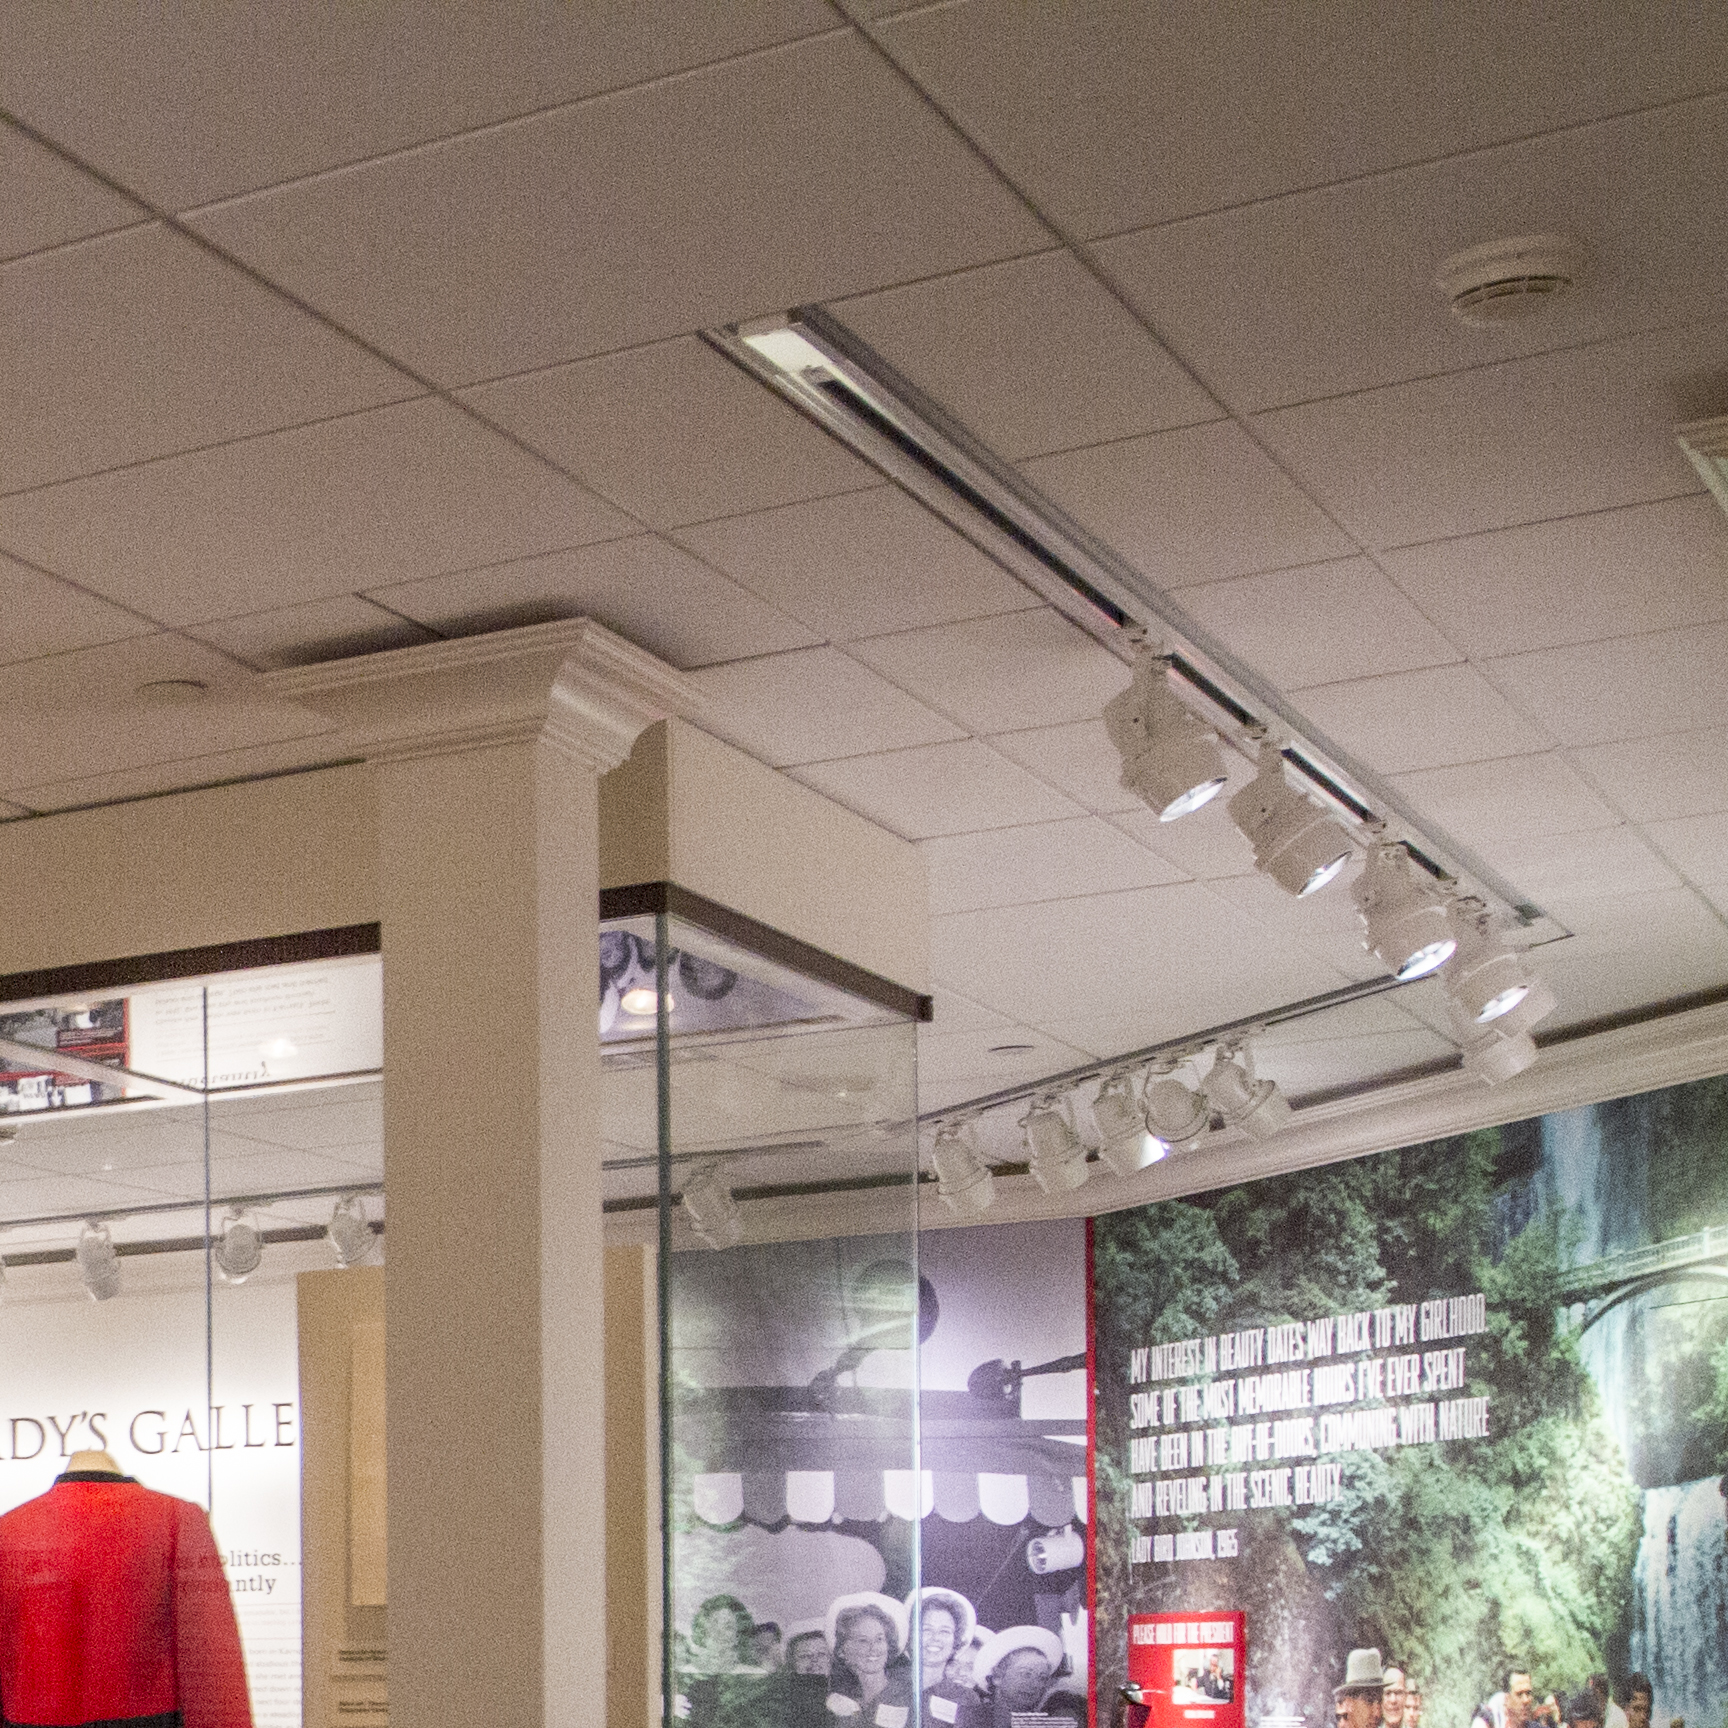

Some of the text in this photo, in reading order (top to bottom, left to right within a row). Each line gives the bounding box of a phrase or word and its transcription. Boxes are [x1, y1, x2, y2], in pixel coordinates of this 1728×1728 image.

[1130, 1347, 1149, 1383] MY
[1151, 1339, 1203, 1380] INTEREST
[1204, 1336, 1217, 1374] IN
[1219, 1329, 1265, 1370] BEAUTY
[1267, 1323, 1305, 1365] DATES
[1306, 1317, 1335, 1359] WAY
[1336, 1313, 1373, 1354] BACK
[1374, 1309, 1393, 1348] TO
[1393, 1304, 1417, 1346] MY
[1130, 1393, 1160, 1429] SOME
[1162, 1390, 1178, 1424] OF
[1179, 1386, 1201, 1423] THE
[1203, 1380, 1235, 1420] MOST
[1237, 1370, 1312, 1416] MEMORABLE
[1312, 1364, 1355, 1406] HOURS
[1387, 1354, 1420, 1397] EVER
[1423, 1348, 1466, 1392] SPENT
[129, 1402, 296, 1455] GALLE
[1130, 1436, 1158, 1474] HAVE
[1159, 1431, 1188, 1470] BEEN
[1190, 1430, 1204, 1467] IN
[1206, 1426, 1229, 1465] THE
[1319, 1408, 1399, 1453] COMMUNING
[1399, 1402, 1436, 1445] WITH
[1438, 1396, 1490, 1440] NATURE
[1130, 1482, 1154, 1518] AND
[1154, 1476, 1208, 1516] REVELING
[1209, 1476, 1224, 1511] IN
[1225, 1473, 1248, 1509] THE
[1249, 1468, 1293, 1507] SCENIC
